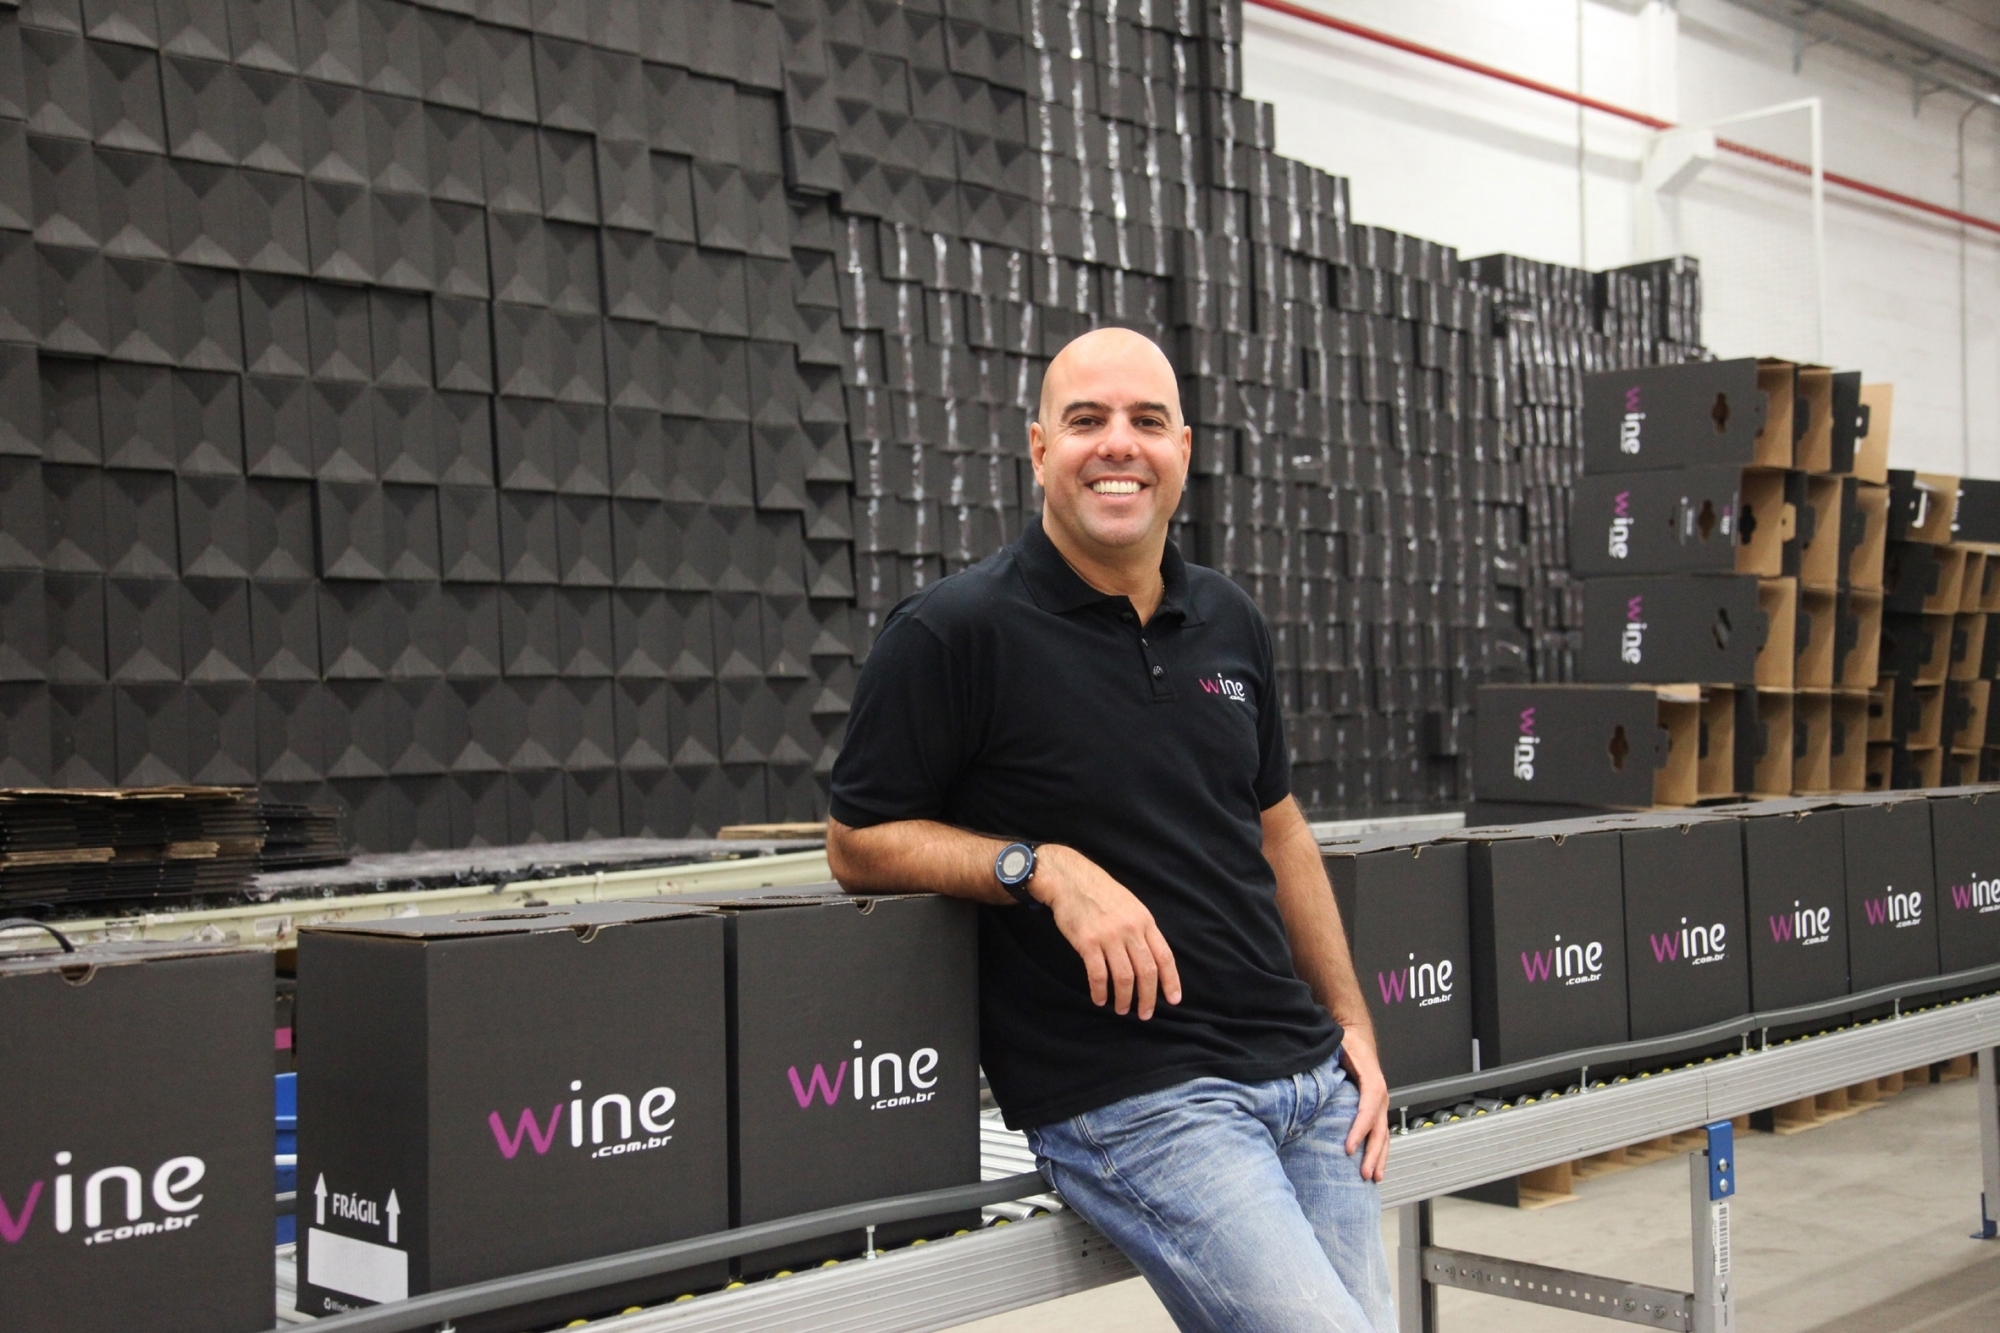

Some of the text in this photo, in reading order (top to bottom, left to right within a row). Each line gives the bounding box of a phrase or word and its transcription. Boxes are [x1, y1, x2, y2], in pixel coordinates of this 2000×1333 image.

[1624, 386, 1646, 454] wine
[1612, 490, 1634, 559] wine
[1626, 594, 1648, 664] wine
[1199, 672, 1245, 697] wine
[1519, 706, 1541, 780] wine
[1769, 900, 1831, 943] wine
[1864, 885, 1922, 926] wine
[1520, 934, 1603, 982] wine
[1650, 917, 1726, 963] wine
[1692, 953, 1725, 966] .com.br
[1802, 935, 1830, 946] .com.br
[1378, 953, 1453, 1005] wine
[1565, 973, 1602, 986] .com.br
[1419, 994, 1452, 1008] .com.br
[787, 1039, 939, 1109] wine
[488, 1079, 676, 1159] wine
[870, 1091, 936, 1110] .com.br
[591, 1135, 672, 1159] .com.br
[84, 1214, 199, 1246] .com.br
[332, 1192, 381, 1226] FRÁGIL
